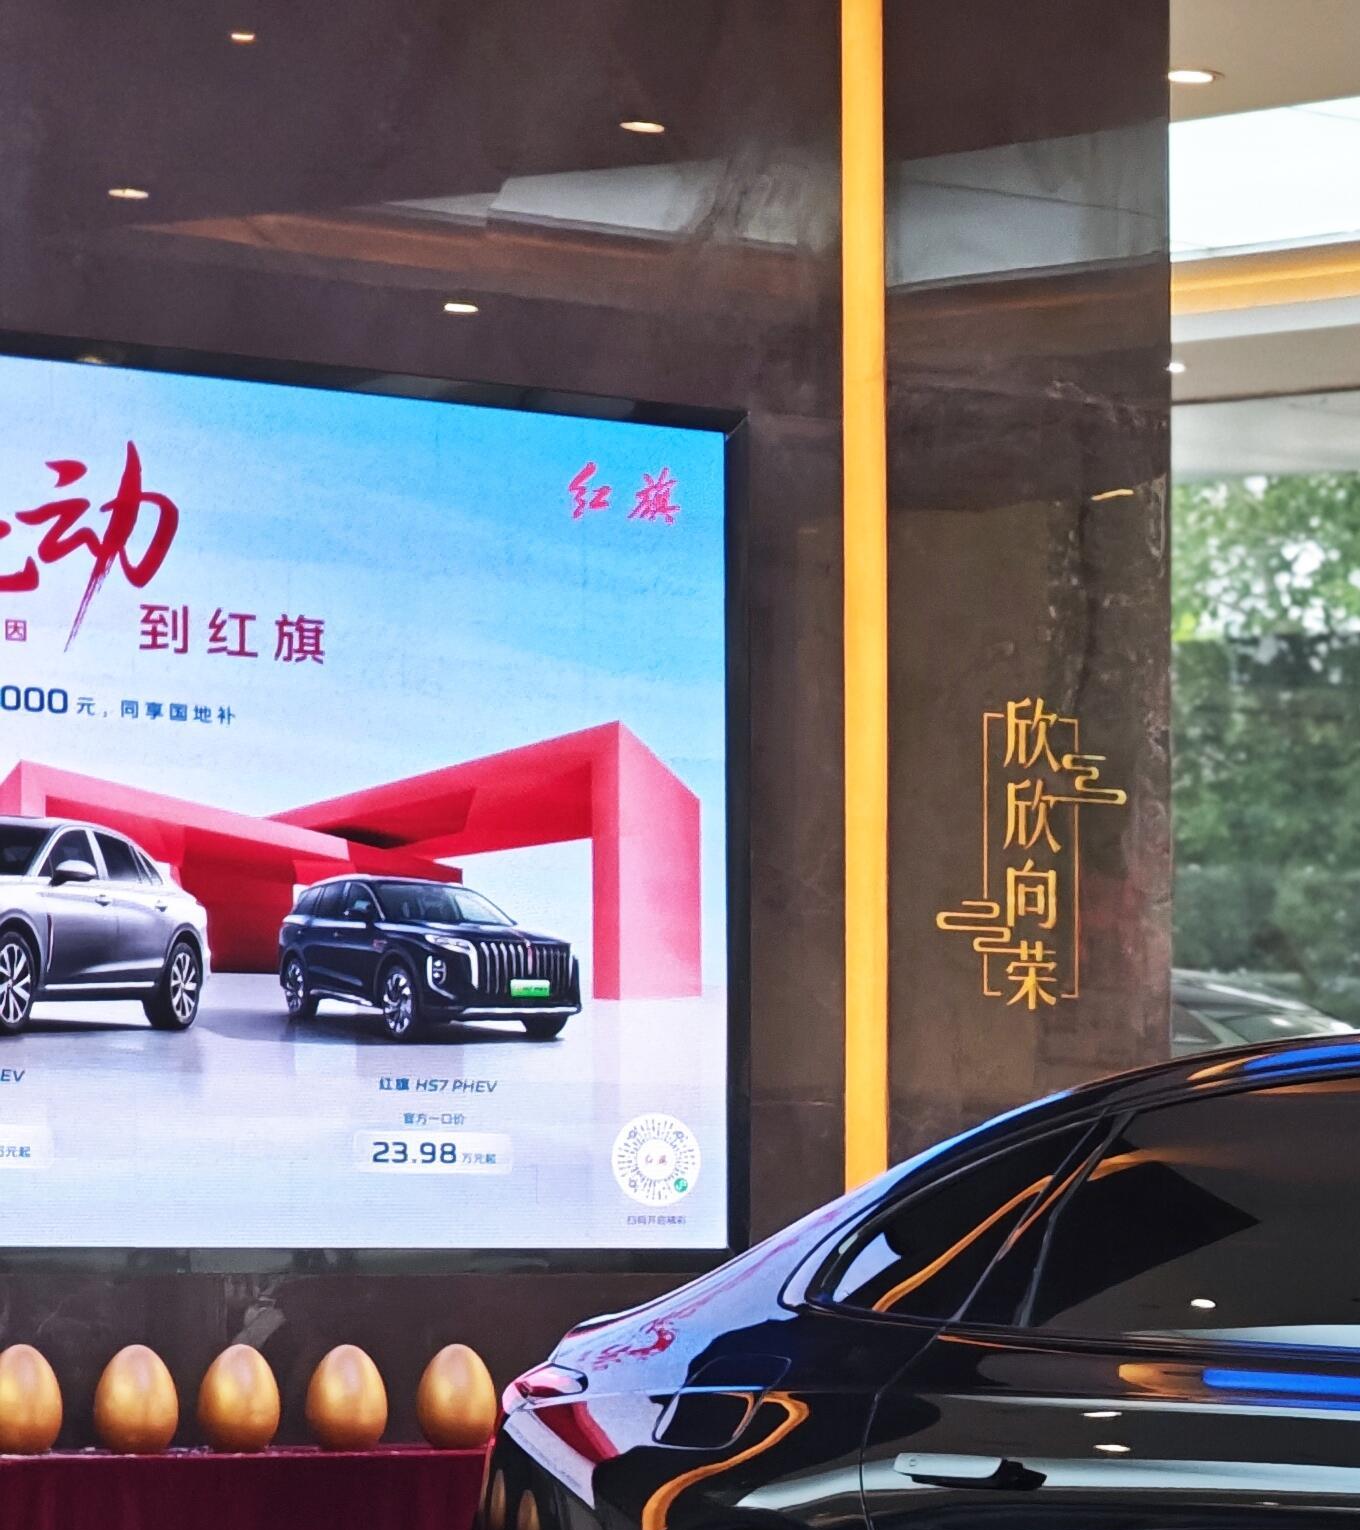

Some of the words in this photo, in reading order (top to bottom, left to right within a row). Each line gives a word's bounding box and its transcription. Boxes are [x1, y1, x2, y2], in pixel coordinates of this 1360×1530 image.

[568, 461, 681, 525] 红旗
[5, 619, 27, 642] 因
[139, 604, 325, 664] 到红旗
[1003, 697, 1063, 1010] 欣欣向荣
[415, 1079, 449, 1092] HS7
[452, 1080, 498, 1093] PHEV
